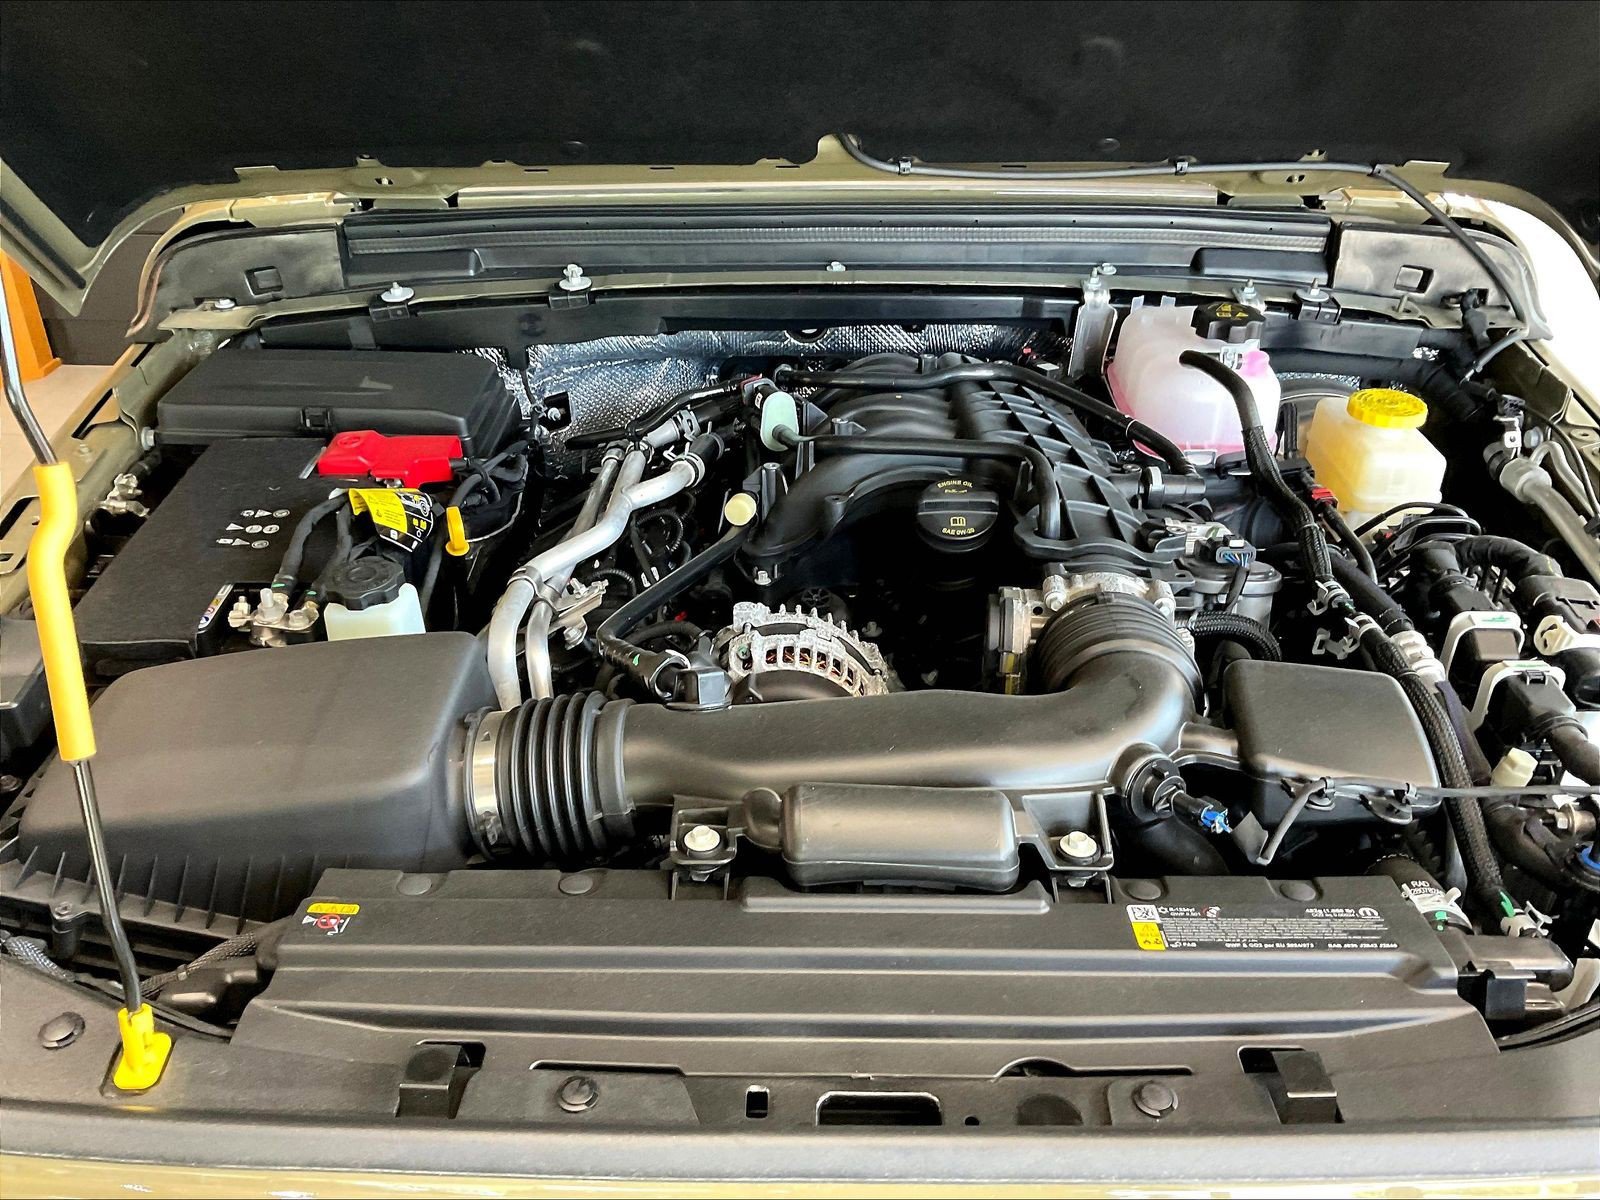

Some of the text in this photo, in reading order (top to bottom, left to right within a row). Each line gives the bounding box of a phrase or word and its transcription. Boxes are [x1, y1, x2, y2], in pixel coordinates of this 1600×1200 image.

[937, 480, 962, 488] ENGINE
[942, 527, 956, 536] SAE
[1410, 880, 1430, 888] RAD
